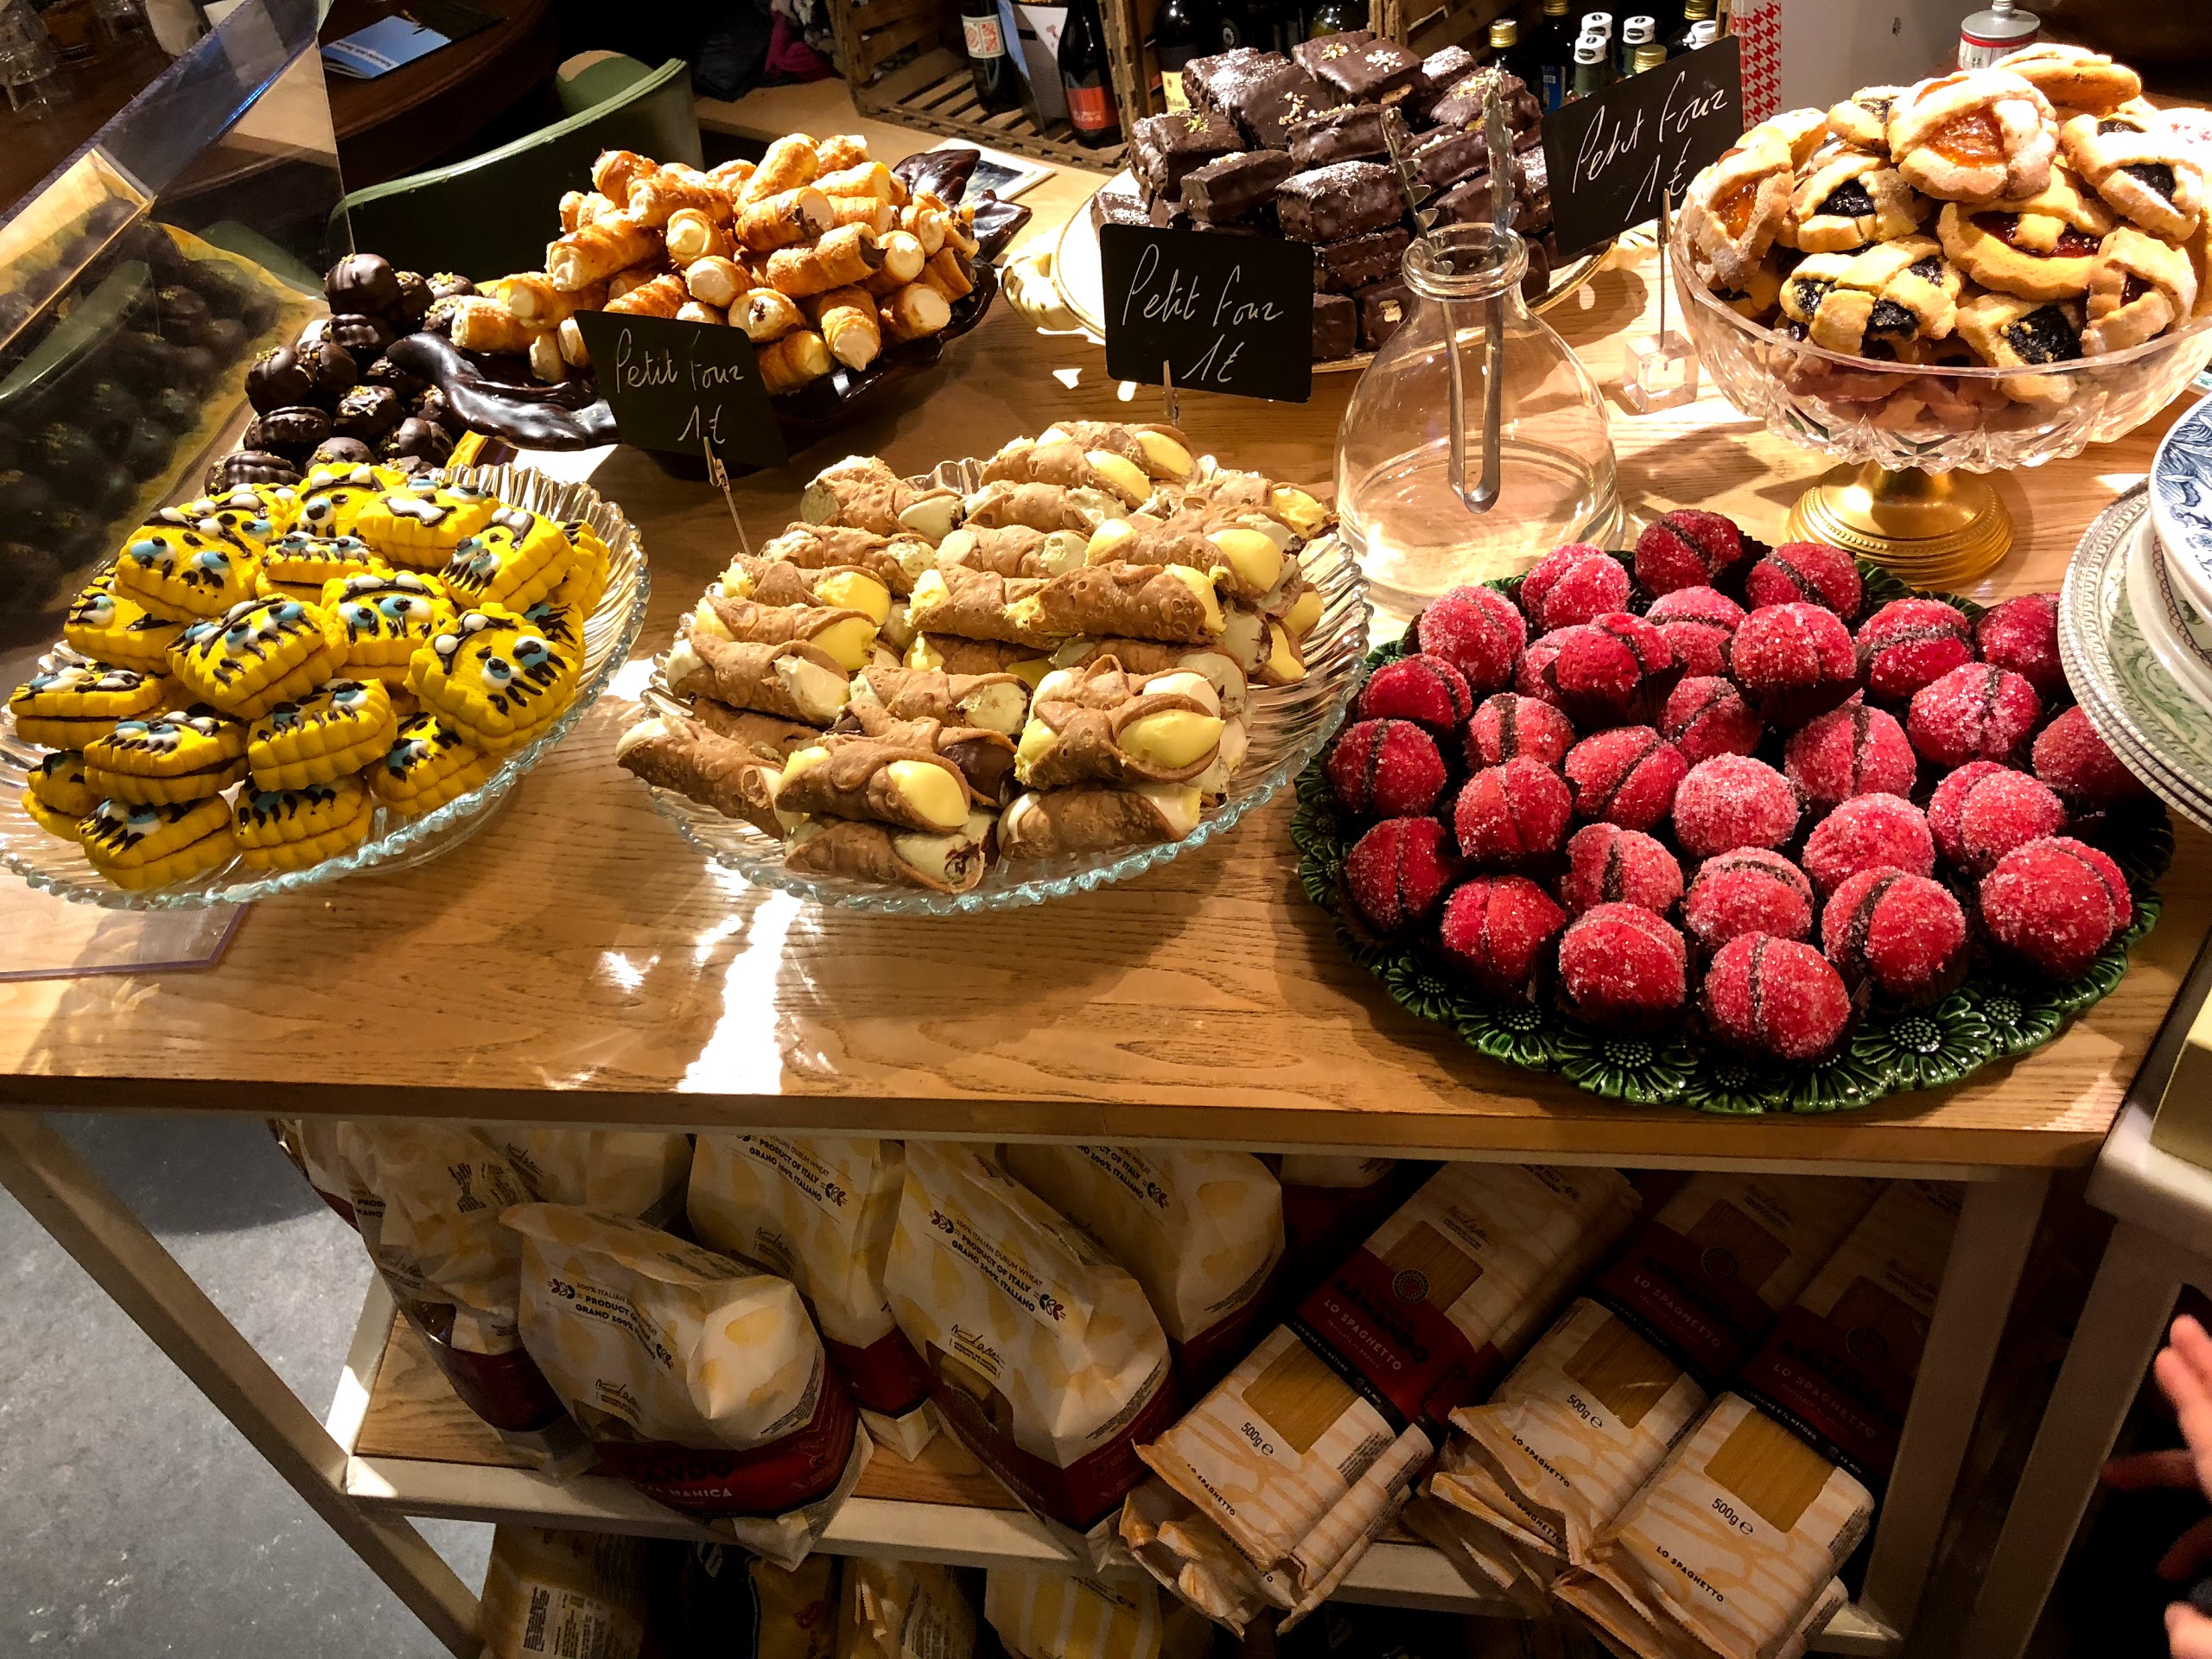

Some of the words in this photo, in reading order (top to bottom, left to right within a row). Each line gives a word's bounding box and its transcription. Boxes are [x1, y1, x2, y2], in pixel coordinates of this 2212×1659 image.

[1572, 105, 1644, 194] Petit
[1122, 243, 1200, 327] Petit
[616, 327, 678, 394] Petit
[749, 1147, 777, 1165] GRANO
[793, 1175, 822, 1201] ITALIANO
[760, 1139, 791, 1164] PRODUCT
[791, 1160, 801, 1171] OF
[801, 1167, 819, 1184] ITALY
[1113, 1168, 1144, 1198] ITALIANO
[951, 1240, 979, 1264] GRANO
[1000, 1280, 1035, 1312] ITALIANO
[962, 1234, 996, 1267] PRODUCT
[997, 1264, 1007, 1275] OF
[1008, 1274, 1031, 1293] ITALY
[972, 1231, 995, 1253] ITALIAN
[995, 1249, 1018, 1271] DURUM
[1019, 1267, 1043, 1287] WHEAT
[575, 1304, 609, 1319] GRANO
[585, 1295, 629, 1315] PRODUCT
[1653, 1288, 1721, 1348] SPAGHETTO
[1323, 1299, 1340, 1313] LO
[1340, 1313, 1402, 1371] SPAGHETTO
[1567, 1394, 1591, 1420] 500g
[1773, 1363, 1792, 1376] LO
[1796, 1376, 1875, 1438] SPAGHETTO
[1241, 1422, 1263, 1447] 500g
[1512, 1434, 1523, 1446] LO
[1524, 1446, 1570, 1487] SPAGHETTO
[1198, 1475, 1236, 1516] SPAGHETTO
[1712, 1497, 1739, 1526] 500g
[1516, 1502, 1563, 1545] SPAGHETTO
[1656, 1546, 1669, 1558] LO
[1671, 1558, 1724, 1602] SPAGHETTO
